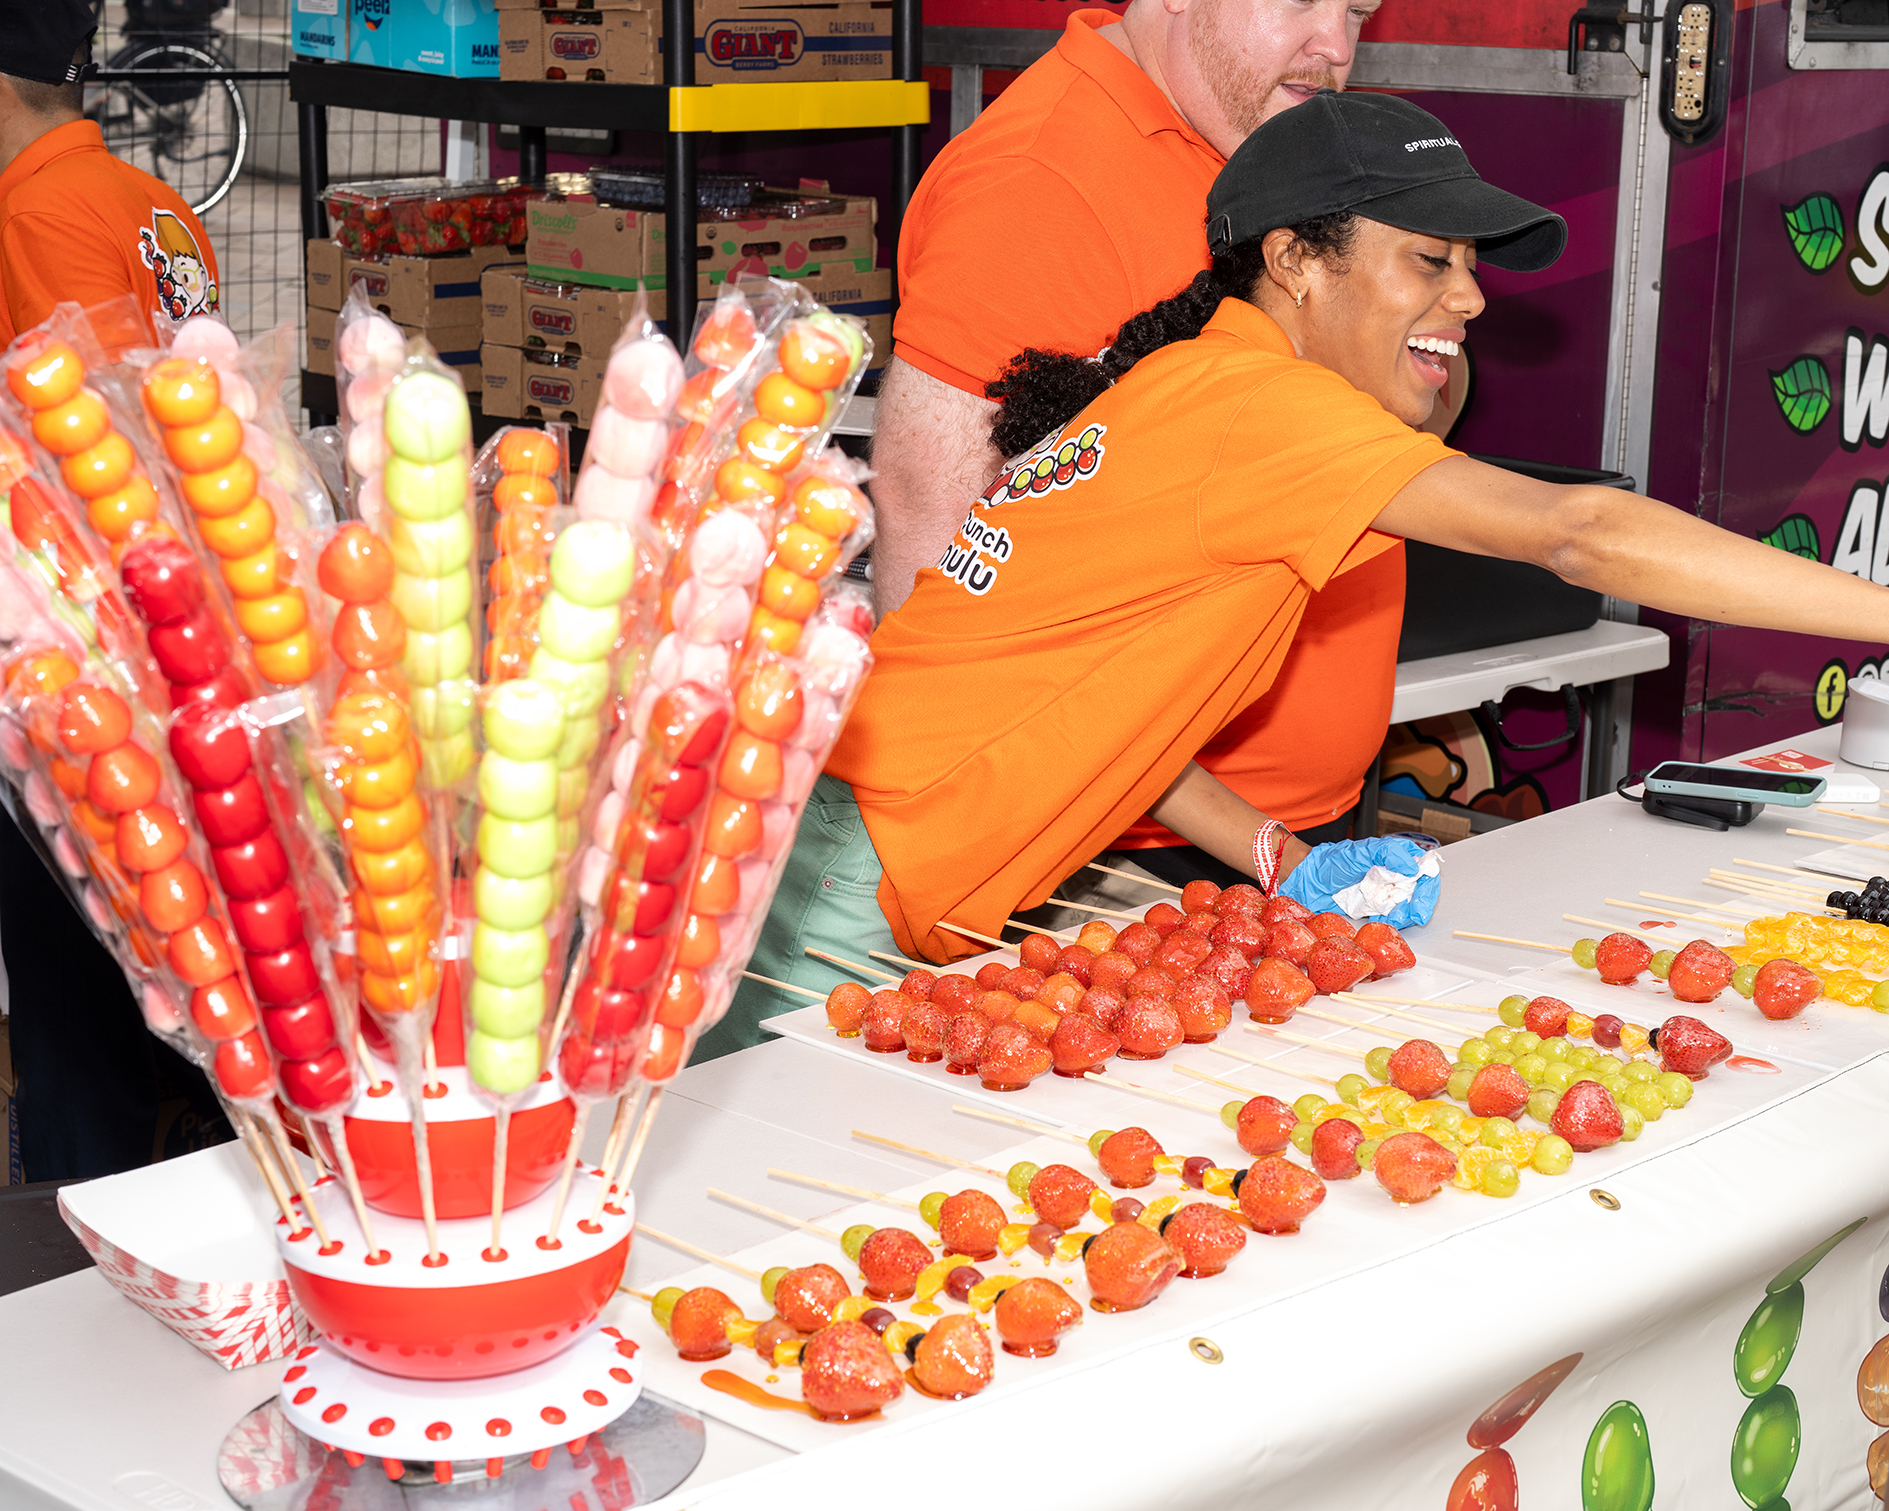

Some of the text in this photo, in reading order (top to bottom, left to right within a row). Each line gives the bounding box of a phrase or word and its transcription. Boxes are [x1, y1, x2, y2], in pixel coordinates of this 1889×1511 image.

[829, 22, 875, 34] CALIFORNIA
[472, 44, 499, 58] MAN
[554, 37, 597, 55] GIANT
[712, 30, 797, 60] GIANT
[822, 53, 883, 66] STRAWBERRIES
[531, 210, 577, 230] Driscoll's
[812, 288, 862, 303] CALIFORNIA
[532, 311, 572, 331] GIANT
[530, 381, 571, 400] GIANT
